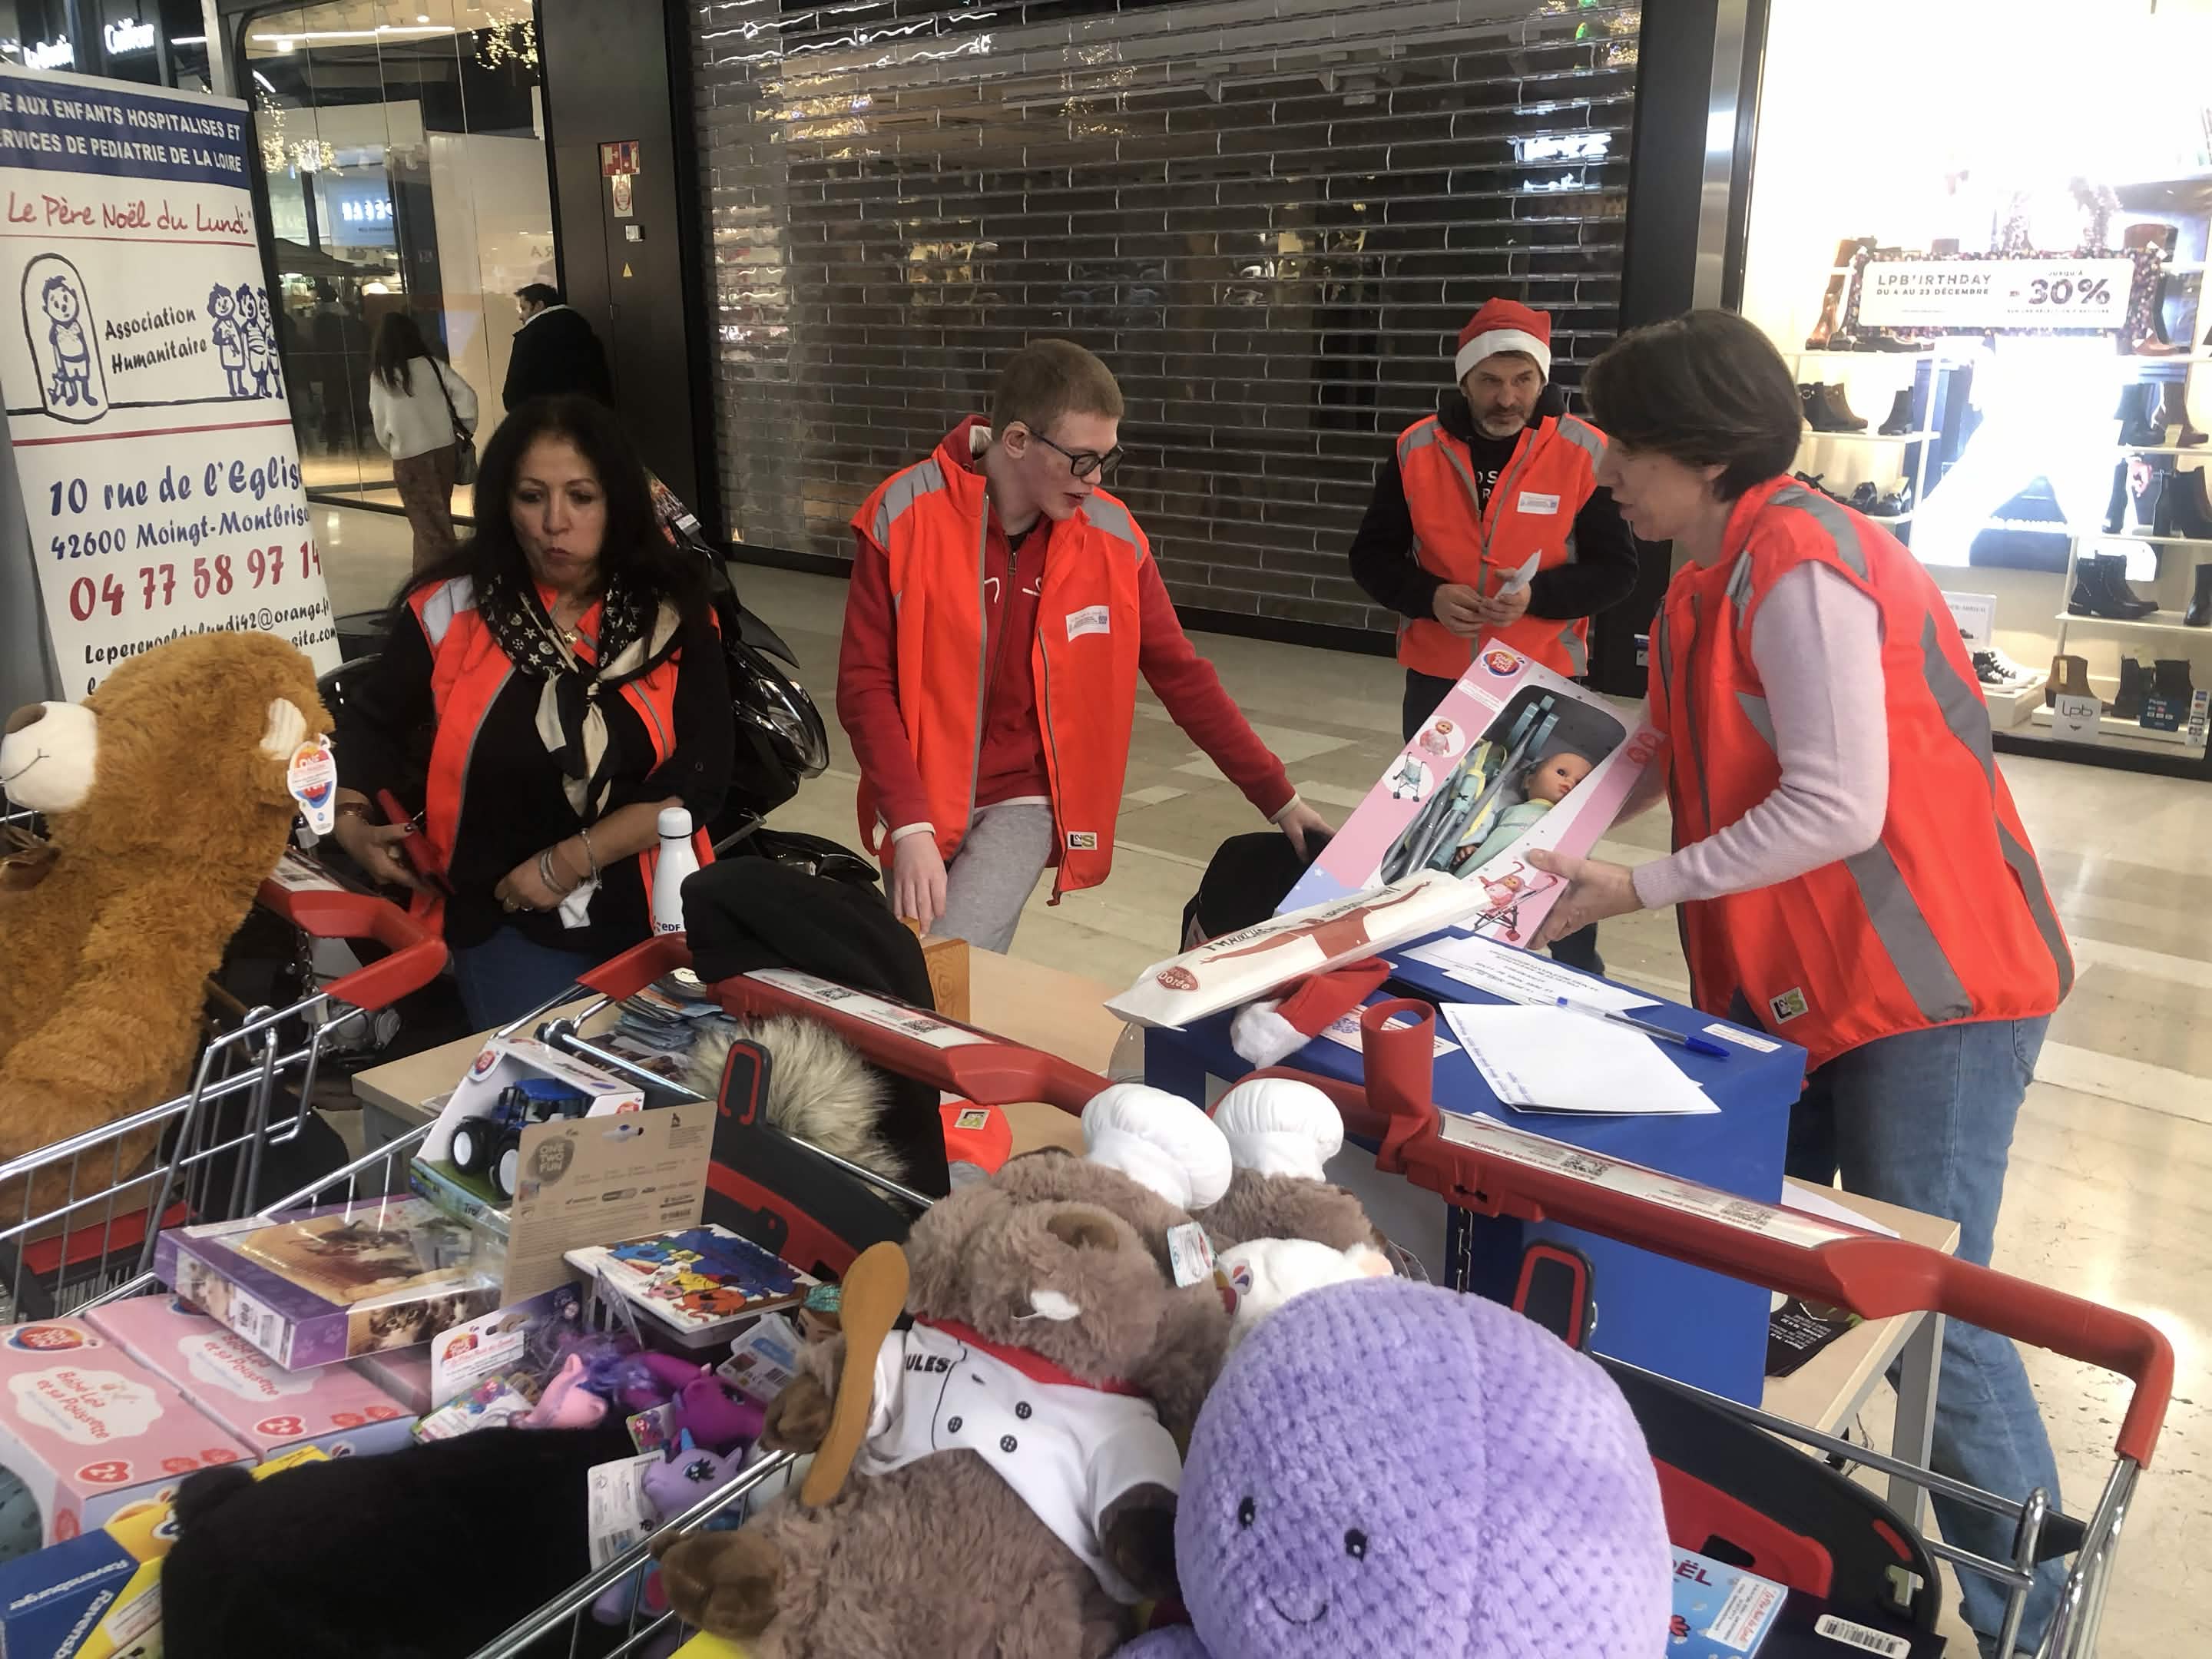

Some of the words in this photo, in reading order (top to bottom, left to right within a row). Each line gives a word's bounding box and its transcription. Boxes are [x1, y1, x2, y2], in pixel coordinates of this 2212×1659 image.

[16, 95, 51, 116] AUX
[51, 99, 124, 125] ENFANTS
[127, 109, 224, 138] HOSPITALISES
[226, 123, 240, 141] ET
[65, 136, 88, 155] DE
[91, 137, 167, 163] PEDIATRIE
[170, 147, 190, 165] DE
[193, 150, 213, 167] LA
[215, 151, 243, 173] LOIRE
[8, 191, 37, 223] Le
[41, 194, 95, 227] Père
[102, 200, 151, 230] Noël
[157, 200, 187, 230] du
[1878, 274, 1991, 286] LPB'IRTHDAY
[104, 304, 197, 340] Association
[111, 336, 208, 375] Humanitaire
[49, 478, 88, 516] 10
[104, 479, 148, 511] rue
[159, 465, 191, 503] de
[204, 454, 303, 500] l'Eglis
[51, 527, 127, 560] 42600
[69, 572, 124, 621] 04
[138, 563, 176, 611] 77
[193, 554, 234, 599] 58
[247, 545, 284, 589] 97
[300, 539, 322, 579] 14
[540, 1142, 565, 1154] ONE
[540, 1152, 565, 1163] TWO
[540, 1161, 563, 1173] FUN
[905, 1353, 952, 1373] ULES
[9, 1560, 129, 1611] Ravensburger
[1672, 1559, 1712, 1587] ËL
